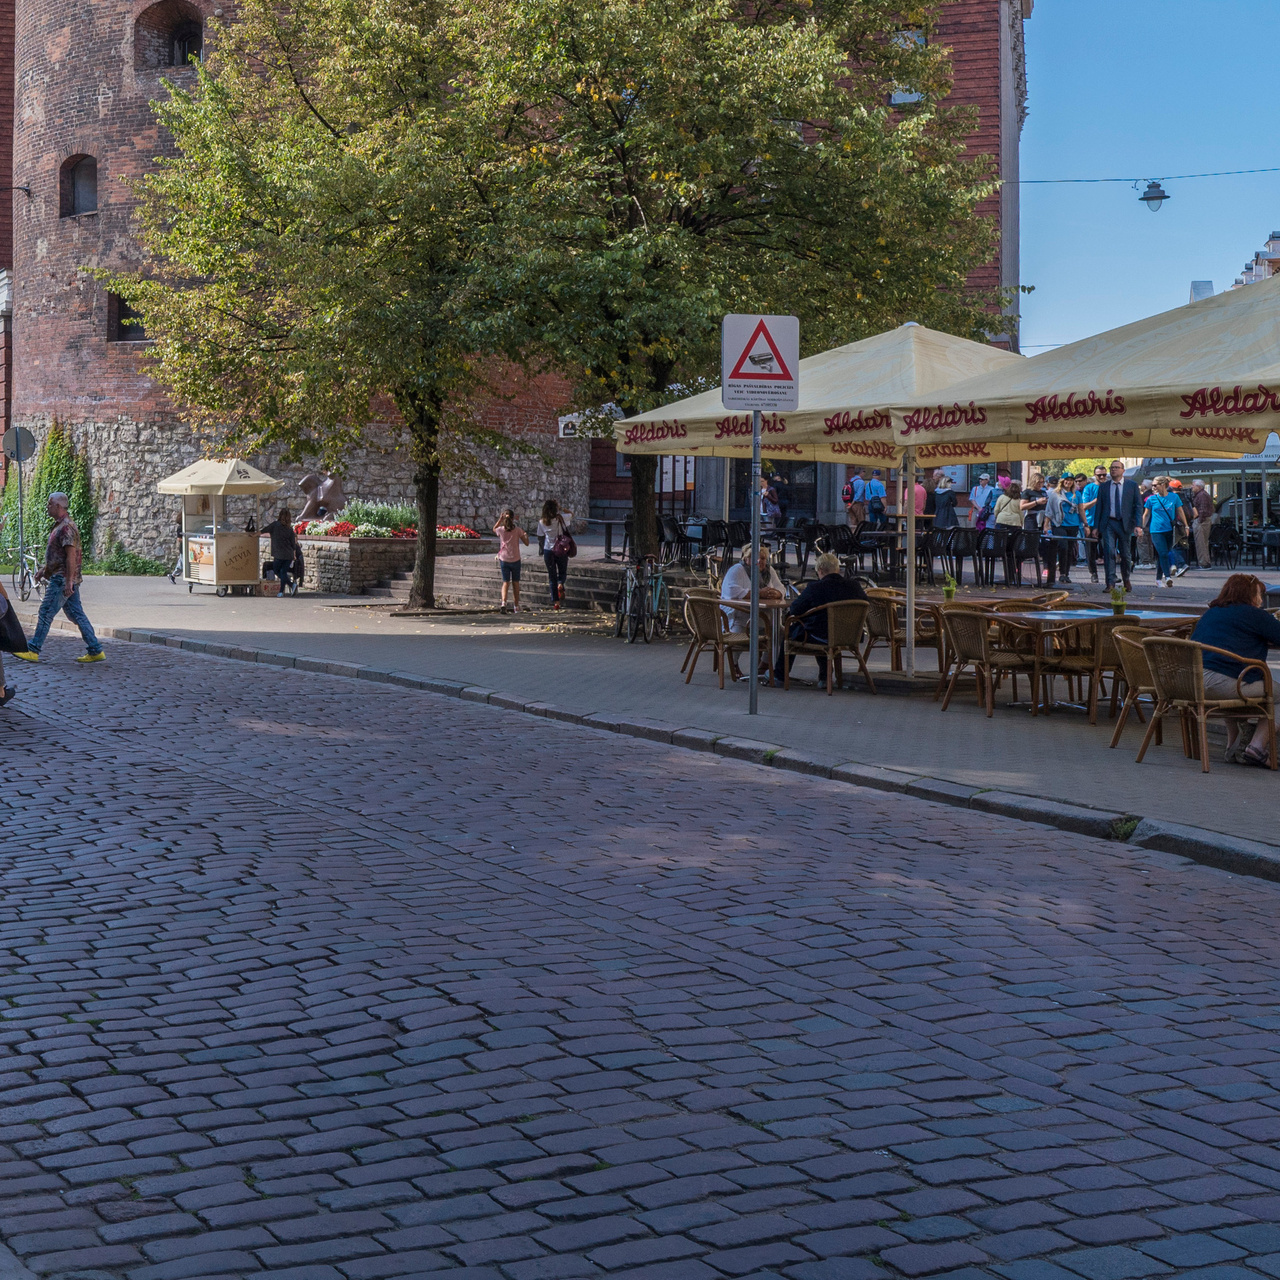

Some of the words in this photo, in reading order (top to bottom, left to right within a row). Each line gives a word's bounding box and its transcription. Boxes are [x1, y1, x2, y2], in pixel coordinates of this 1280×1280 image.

[900, 400, 987, 436] Aldaris
[1025, 389, 1127, 424] Aldaris
[624, 419, 687, 446] Aldaris
[714, 412, 787, 439] Aldris
[224, 549, 252, 567] LATVIA
